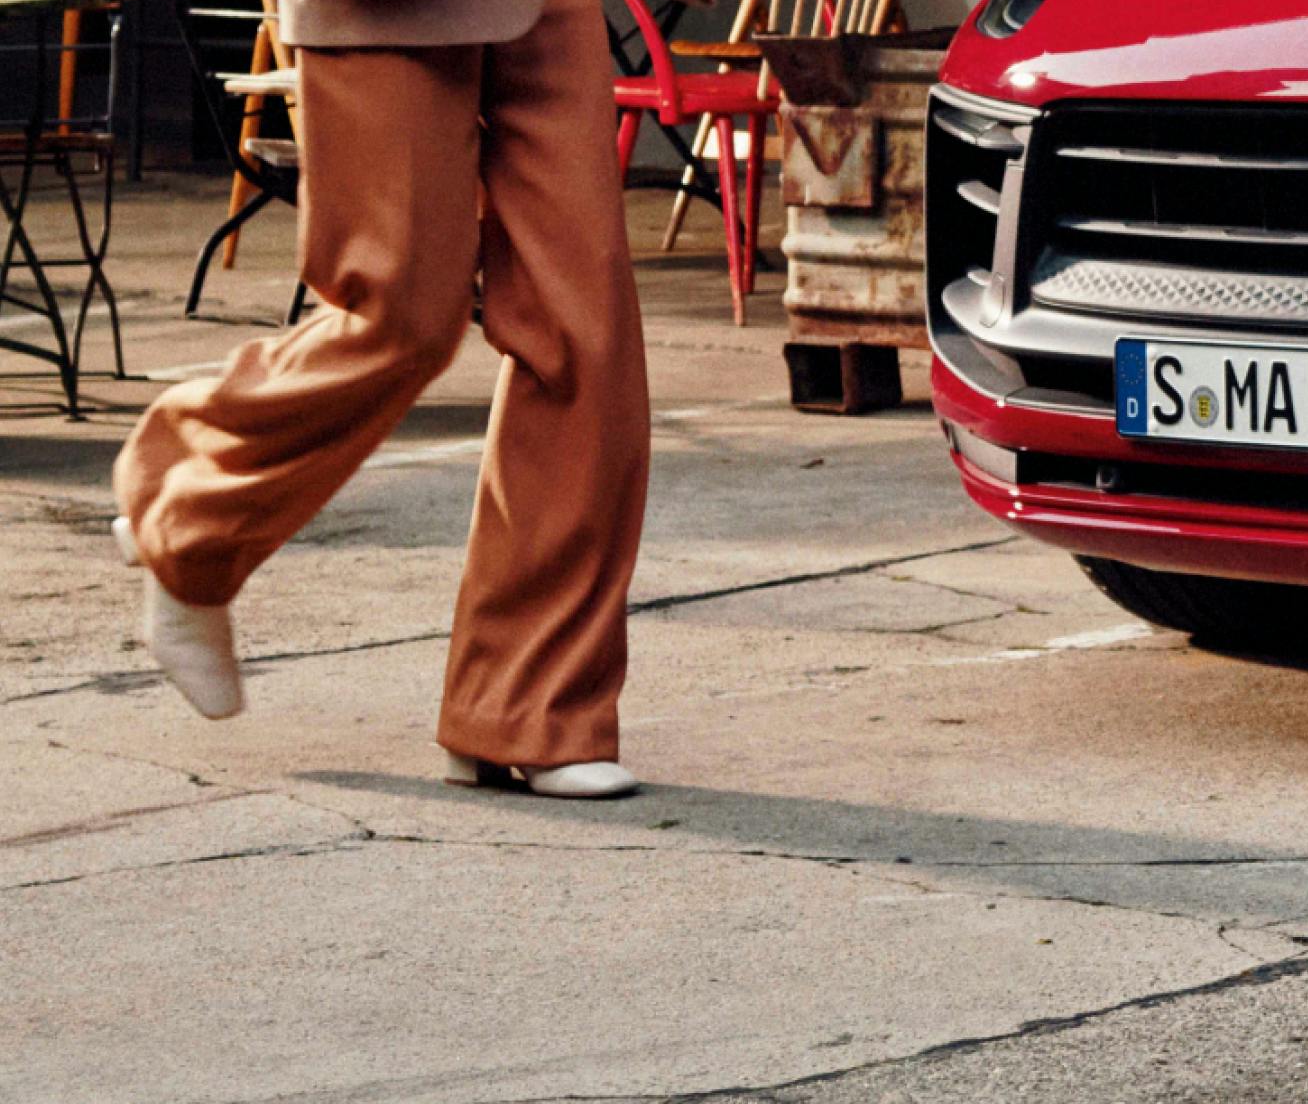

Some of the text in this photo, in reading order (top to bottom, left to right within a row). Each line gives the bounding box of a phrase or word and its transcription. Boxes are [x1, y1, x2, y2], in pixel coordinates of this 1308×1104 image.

[1126, 398, 1138, 418] D
[1153, 355, 1184, 426] S
[1224, 359, 1298, 435] MA
